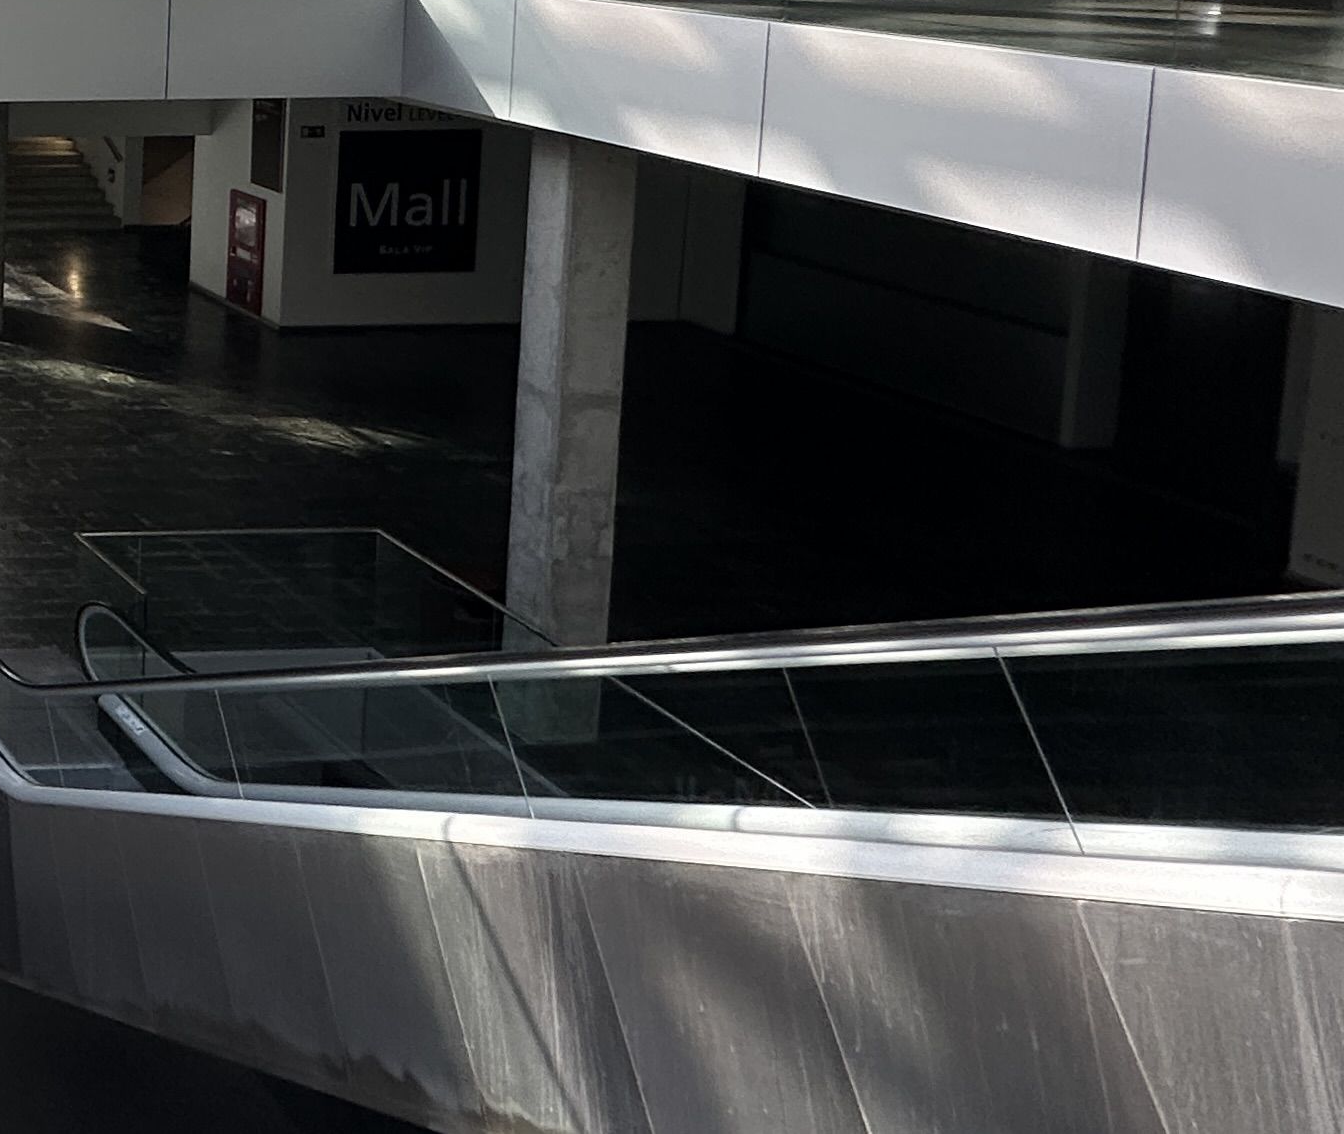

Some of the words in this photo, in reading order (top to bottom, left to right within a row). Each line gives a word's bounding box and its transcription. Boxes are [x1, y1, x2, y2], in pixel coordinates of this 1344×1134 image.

[348, 103, 403, 122] Nivel
[410, 107, 454, 121] LEVE
[349, 178, 468, 227] Mall
